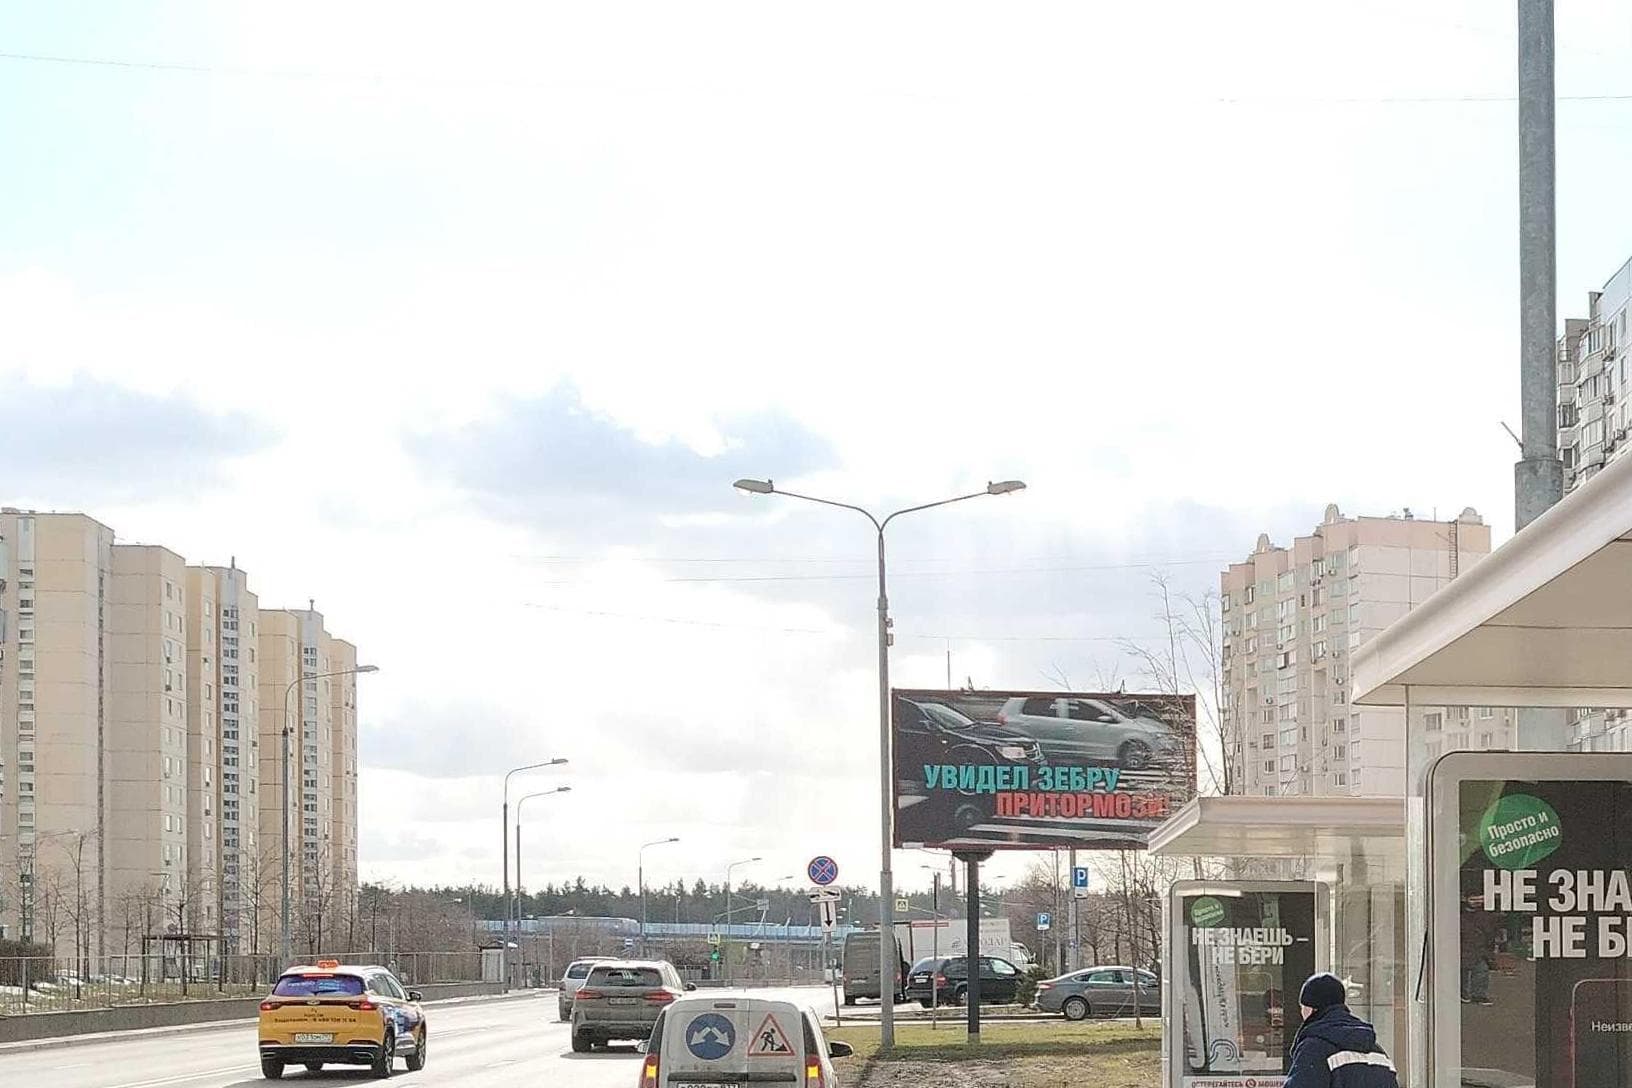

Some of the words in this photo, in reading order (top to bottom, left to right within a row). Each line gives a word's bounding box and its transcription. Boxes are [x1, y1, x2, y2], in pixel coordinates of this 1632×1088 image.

[923, 764, 1030, 793] УВИДЕЛ
[1038, 766, 1121, 792] ЗЕБРУ
[1487, 814, 1536, 840] Просто
[1539, 811, 1548, 822] и
[1488, 825, 1560, 858] безопасно
[1483, 869, 1538, 912] НЕ
[1192, 927, 1215, 945] НЕ
[1219, 927, 1293, 946] ЗНАЕШЬ
[1532, 916, 1587, 958] НЕ
[1239, 946, 1284, 965] БЕРИ
